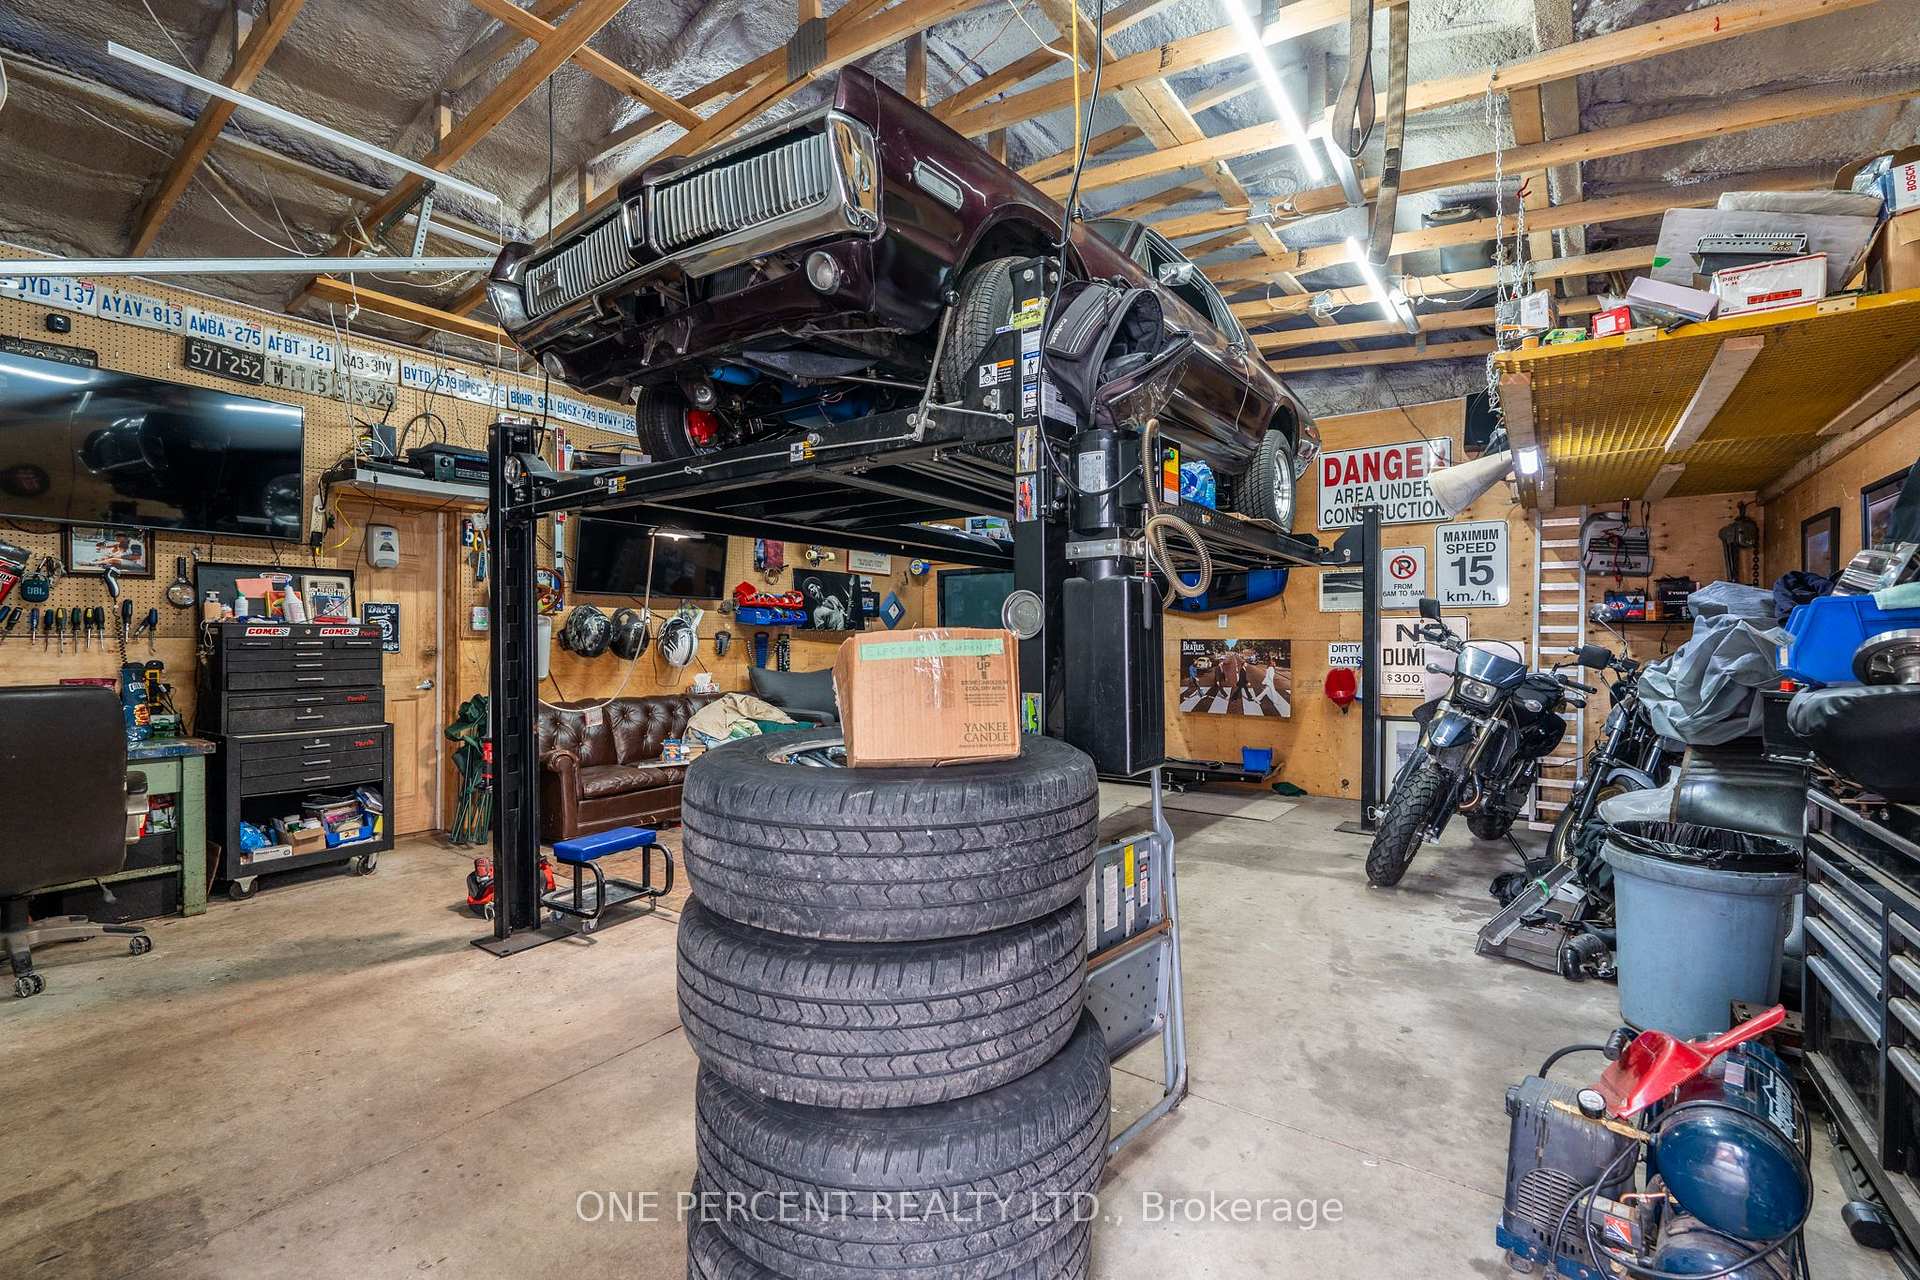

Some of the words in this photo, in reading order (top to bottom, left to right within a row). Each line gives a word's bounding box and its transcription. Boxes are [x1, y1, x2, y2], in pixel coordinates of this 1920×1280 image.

[1905, 164, 1917, 191] BOSCH
[1334, 486, 1375, 505] AREA
[1324, 500, 1446, 525] CONSRUCTION
[1444, 529, 1499, 542] MAXIMUM
[1446, 542, 1496, 555] SPEED
[1451, 555, 1495, 587] 15
[321, 627, 350, 635] COMP
[1331, 644, 1361, 653] DIRTY
[976, 661, 991, 671] UP
[1330, 656, 1362, 665] PARTS
[964, 722, 1009, 732] YANKEE
[964, 732, 1009, 743] CANDLE
